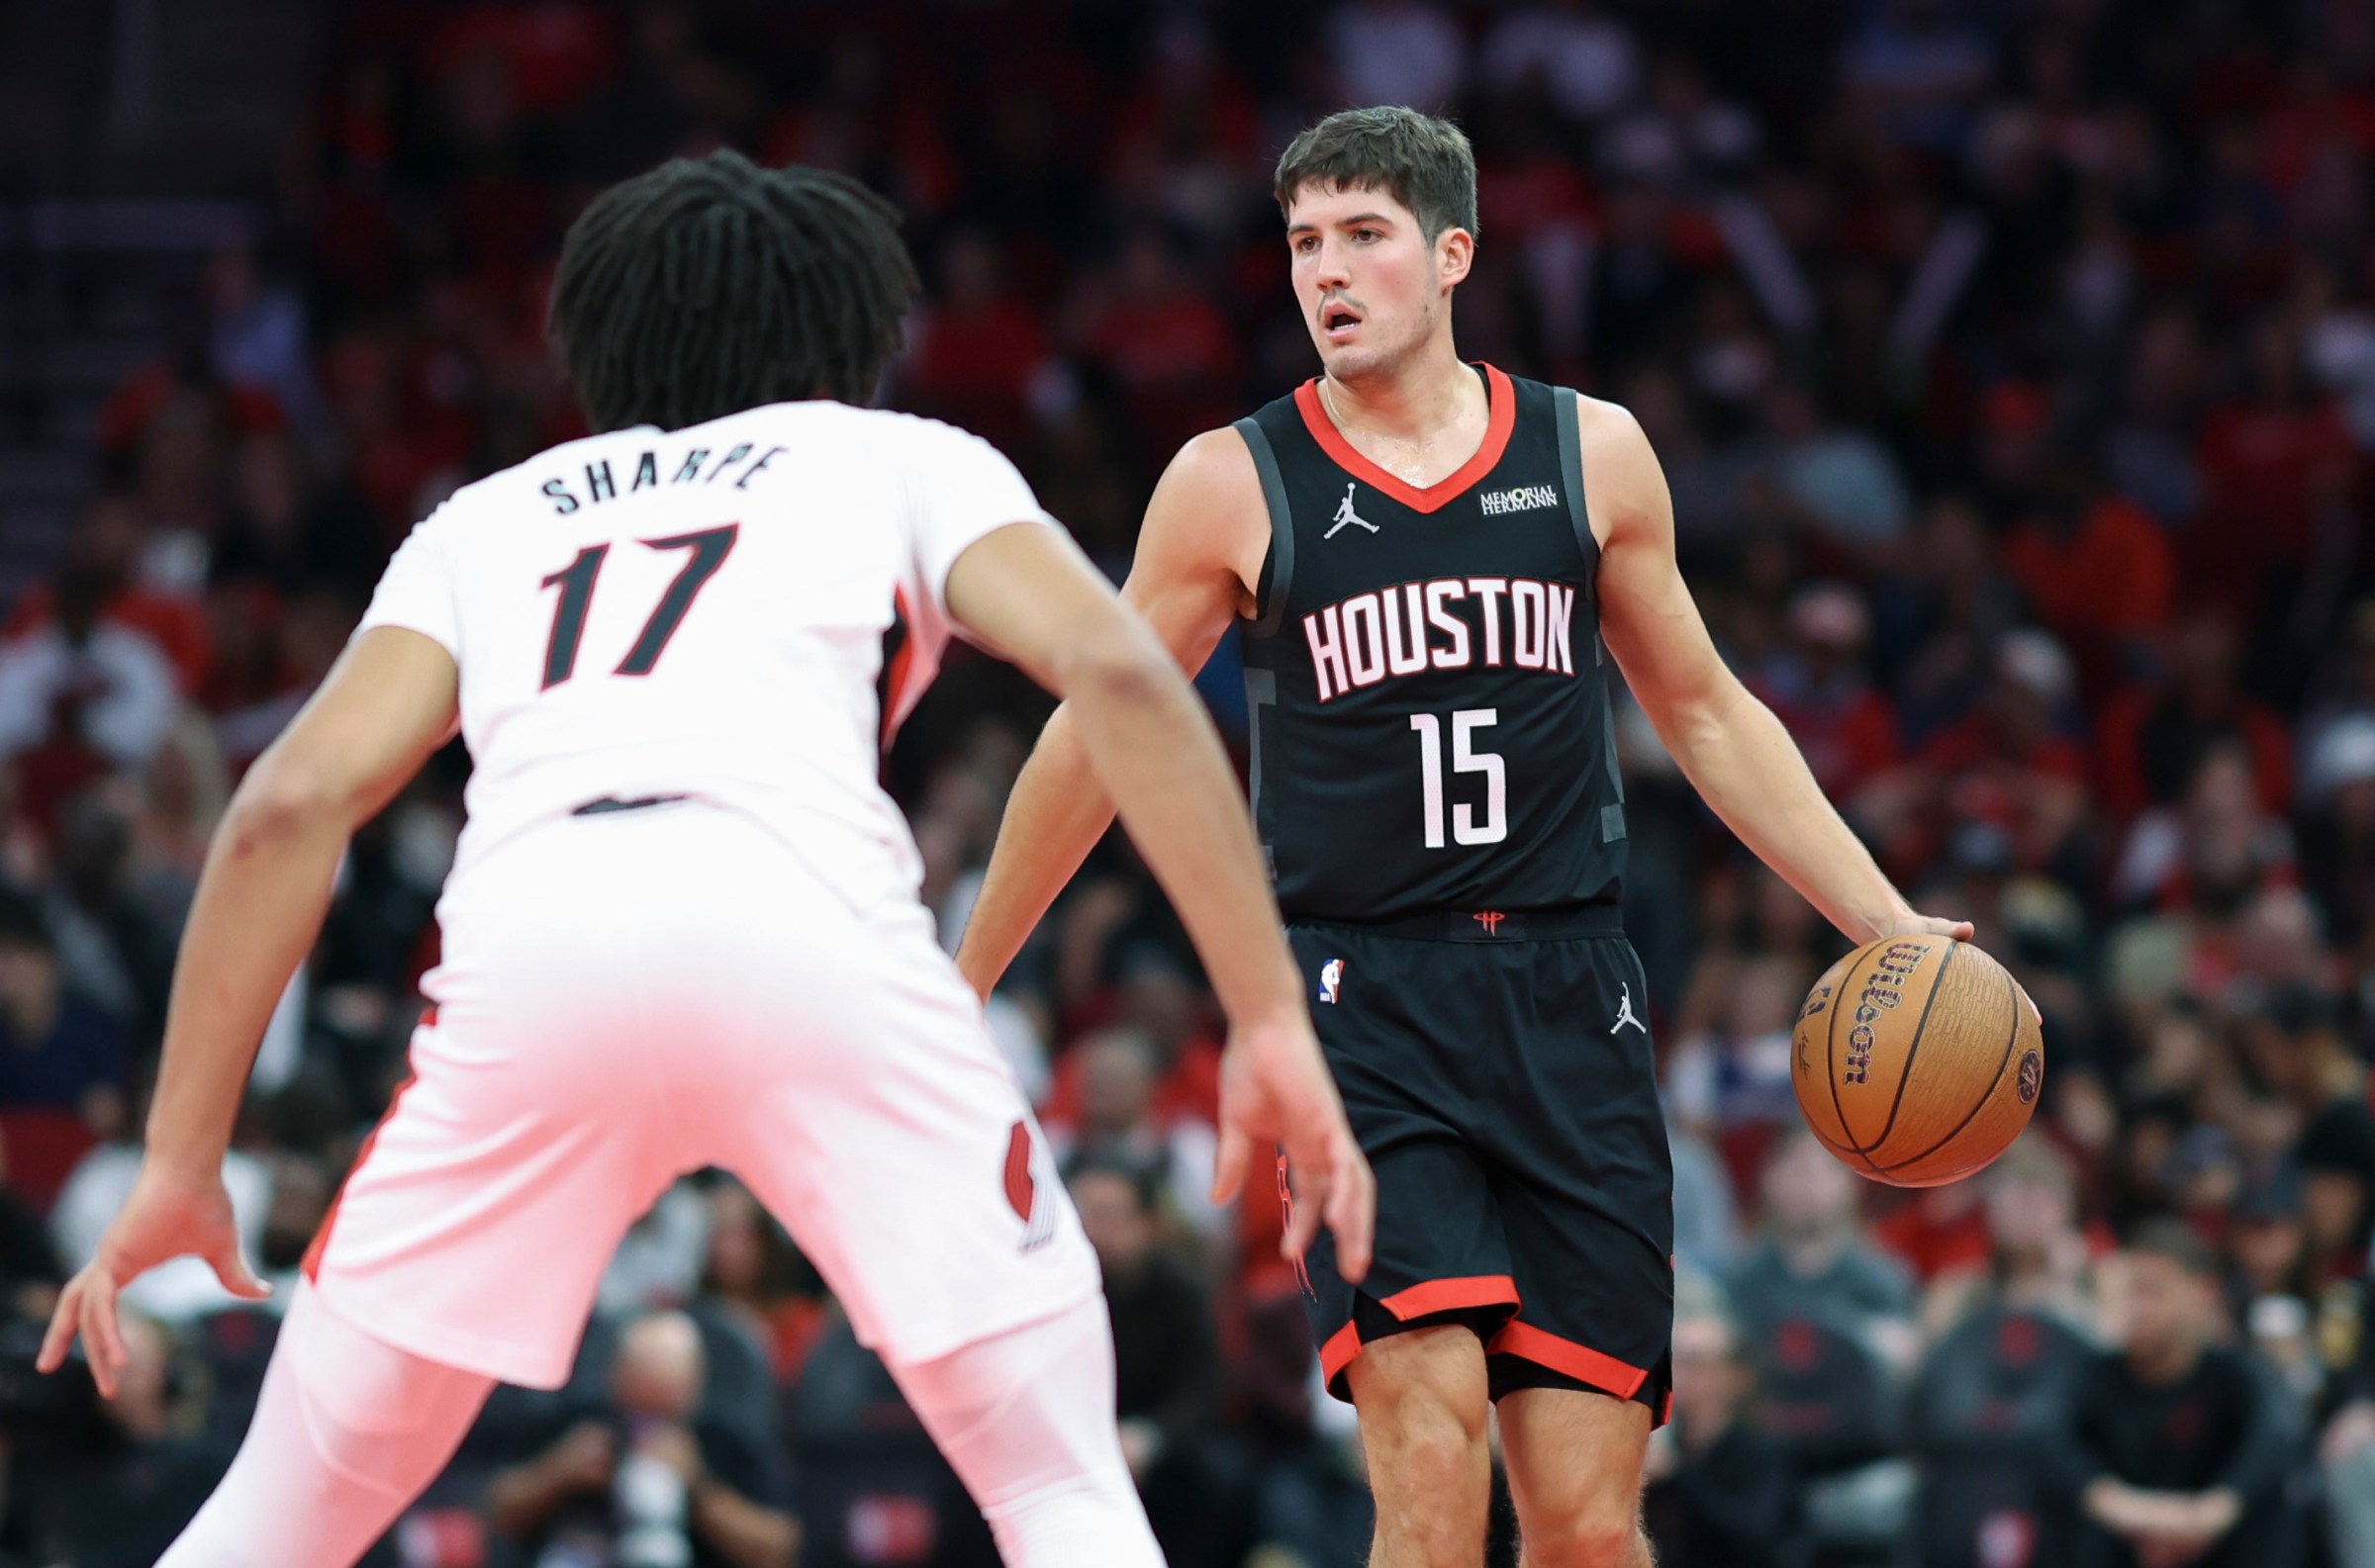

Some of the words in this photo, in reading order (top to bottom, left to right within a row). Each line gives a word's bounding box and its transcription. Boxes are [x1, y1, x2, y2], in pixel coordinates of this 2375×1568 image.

[541, 443, 788, 514] SHARPE
[1480, 485, 1555, 505] MEMORIAL
[1481, 493, 1558, 514] HERMANN
[540, 521, 740, 692] 17
[1301, 576, 1574, 703] HOUSTON
[1409, 708, 1507, 848] 15
[1844, 943, 1932, 1086] Wilson
